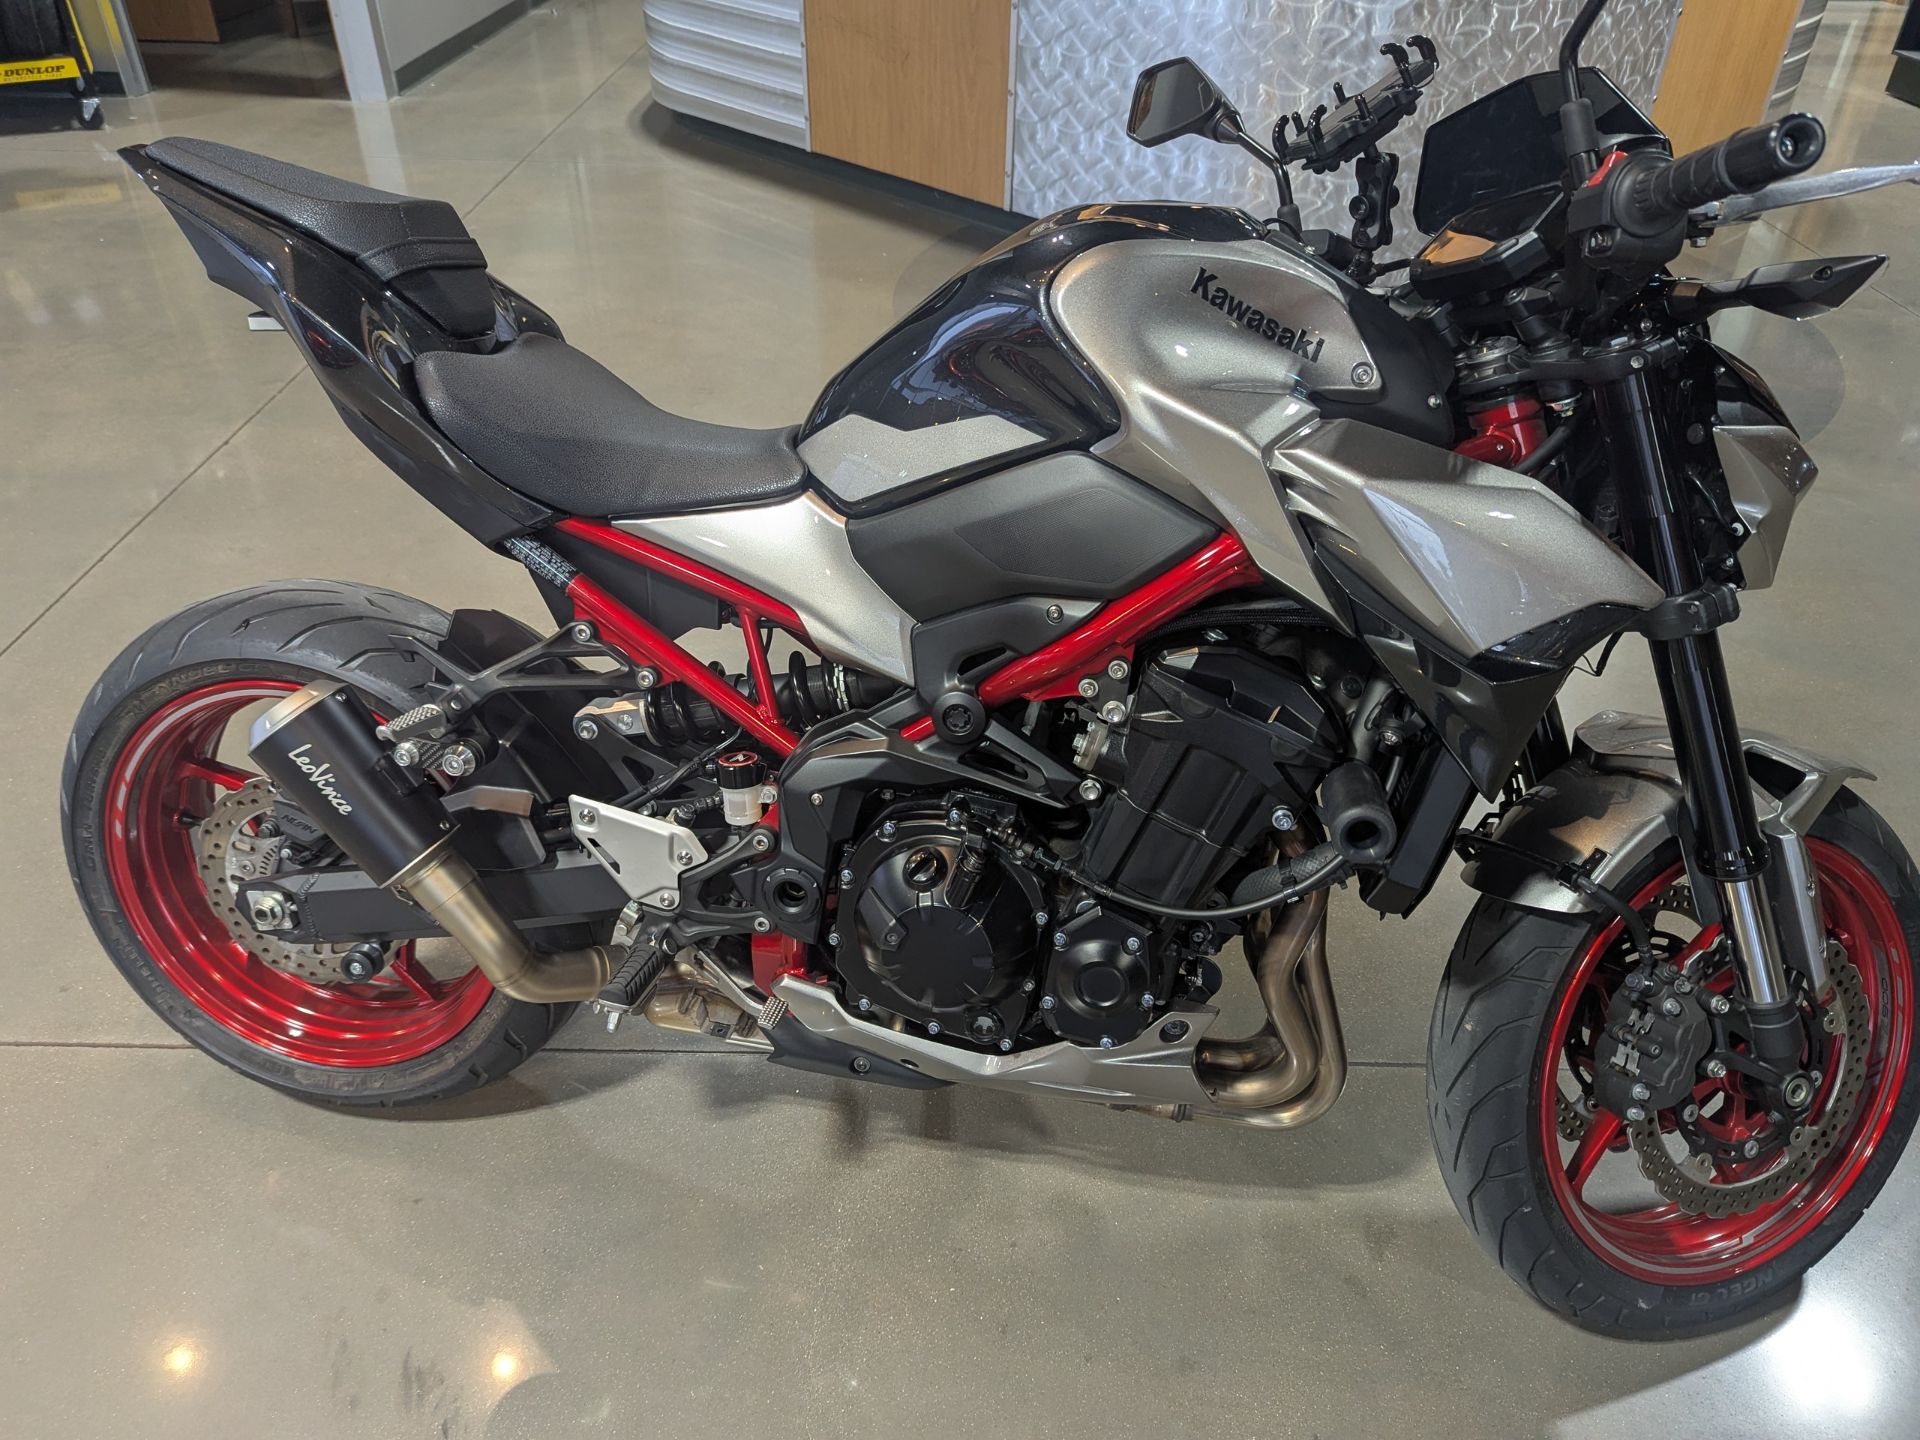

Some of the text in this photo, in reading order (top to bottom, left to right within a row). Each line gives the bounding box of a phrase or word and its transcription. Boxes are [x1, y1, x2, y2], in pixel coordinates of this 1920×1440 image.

[4, 65, 66, 77] DUNLOP
[1190, 266, 1326, 363] Kawasaki
[287, 743, 353, 816] LeoVince
